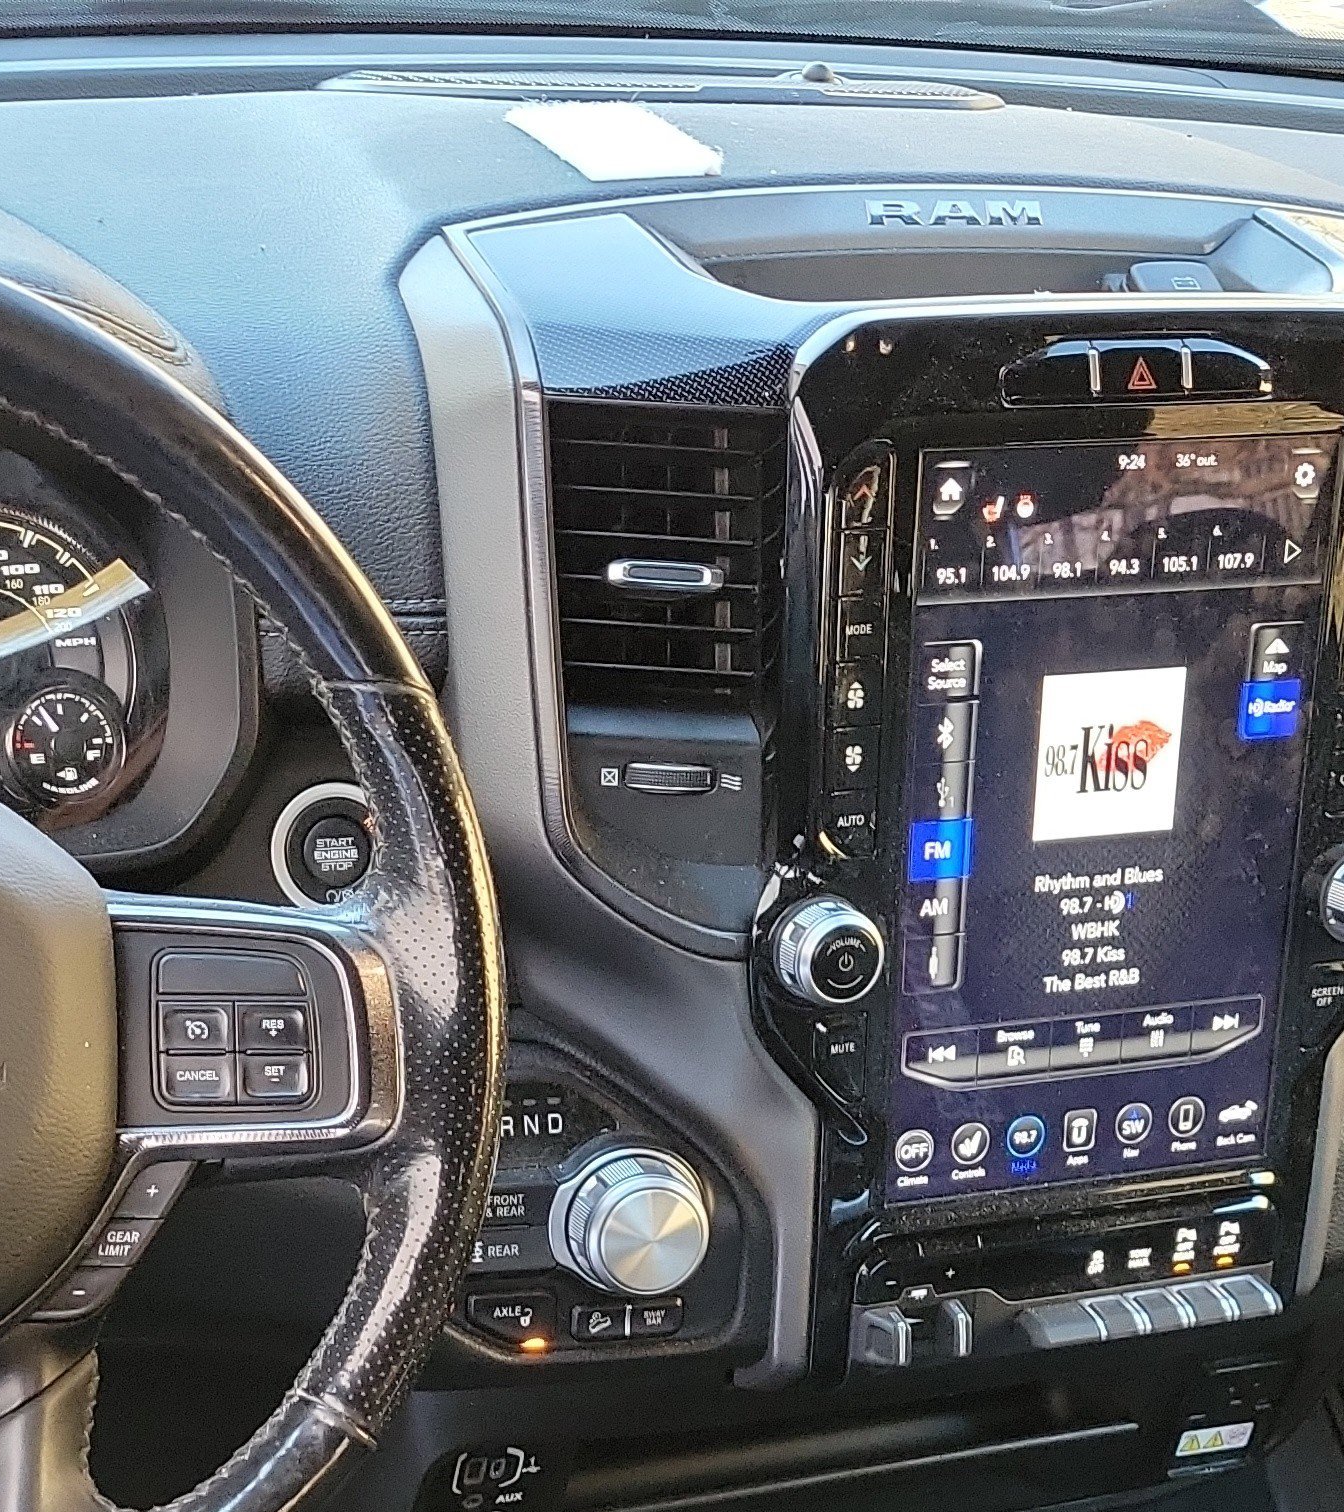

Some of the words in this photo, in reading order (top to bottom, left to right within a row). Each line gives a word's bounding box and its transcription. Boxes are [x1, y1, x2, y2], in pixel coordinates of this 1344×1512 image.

[865, 199, 1044, 226] RAM
[1119, 454, 1145, 469] 9:24
[1109, 559, 1140, 575] 94.3
[1162, 556, 1198, 573] 105.1
[1217, 553, 1255, 570] 107.9
[1, 563, 40, 576] 100
[937, 567, 966, 584] 95.1
[992, 564, 1030, 581] 104.9
[1053, 562, 1082, 578] 98.1
[4, 578, 24, 591] 160
[32, 583, 65, 596] 110
[45, 608, 82, 619] 120
[845, 623, 872, 635] MODE
[55, 636, 97, 648] MPH
[931, 657, 966, 673] Select
[1262, 660, 1286, 676] Map
[928, 675, 967, 691] Source
[30, 754, 45, 765] E
[87, 748, 101, 760] F
[1044, 745, 1079, 778] 98.7
[1076, 724, 1150, 794] Kiss
[42, 777, 99, 794] GASOLINE
[837, 813, 865, 828] AUTO
[316, 837, 354, 848] START
[314, 849, 358, 861] ENGINE
[923, 841, 951, 860] FM
[321, 861, 353, 872] STOP
[1034, 871, 1088, 894] Rhythm
[1092, 871, 1121, 889] and
[1124, 865, 1164, 884] Blues
[920, 898, 948, 916] AM
[1060, 897, 1093, 916] 98.7
[1071, 919, 1120, 941] WBHK
[830, 936, 862, 951] VOLUME
[1061, 948, 1093, 966] 98.7
[1096, 945, 1125, 964] Kiss
[1043, 974, 1071, 993] The
[1074, 971, 1106, 991] Best
[1108, 967, 1140, 988] R&B
[1311, 986, 1344, 998] SCREEN
[1316, 997, 1333, 1007] OFF
[262, 1019, 285, 1031] RES
[1142, 1011, 1174, 1026] Audio
[1075, 1020, 1100, 1035] Tune
[997, 1028, 1035, 1043] Browse
[830, 1040, 856, 1054] MUTE
[176, 1069, 219, 1082] CANCEL
[264, 1066, 285, 1077] SET
[501, 1116, 514, 1137] R
[523, 1114, 538, 1136] N
[548, 1113, 563, 1134] D
[1122, 1122, 1145, 1135] SW
[1014, 1129, 1038, 1145] 98.7
[900, 1142, 928, 1158] OFF
[897, 1174, 929, 1187] Climate
[952, 1167, 986, 1181] Controls
[487, 1193, 525, 1206] FRONT
[496, 1205, 525, 1217] REAR
[107, 1231, 140, 1244] GEAR
[98, 1244, 132, 1257] LIMIT
[488, 1244, 520, 1257] REAR
[493, 1306, 522, 1319] AXLE
[495, 1491, 523, 1504] AUX
